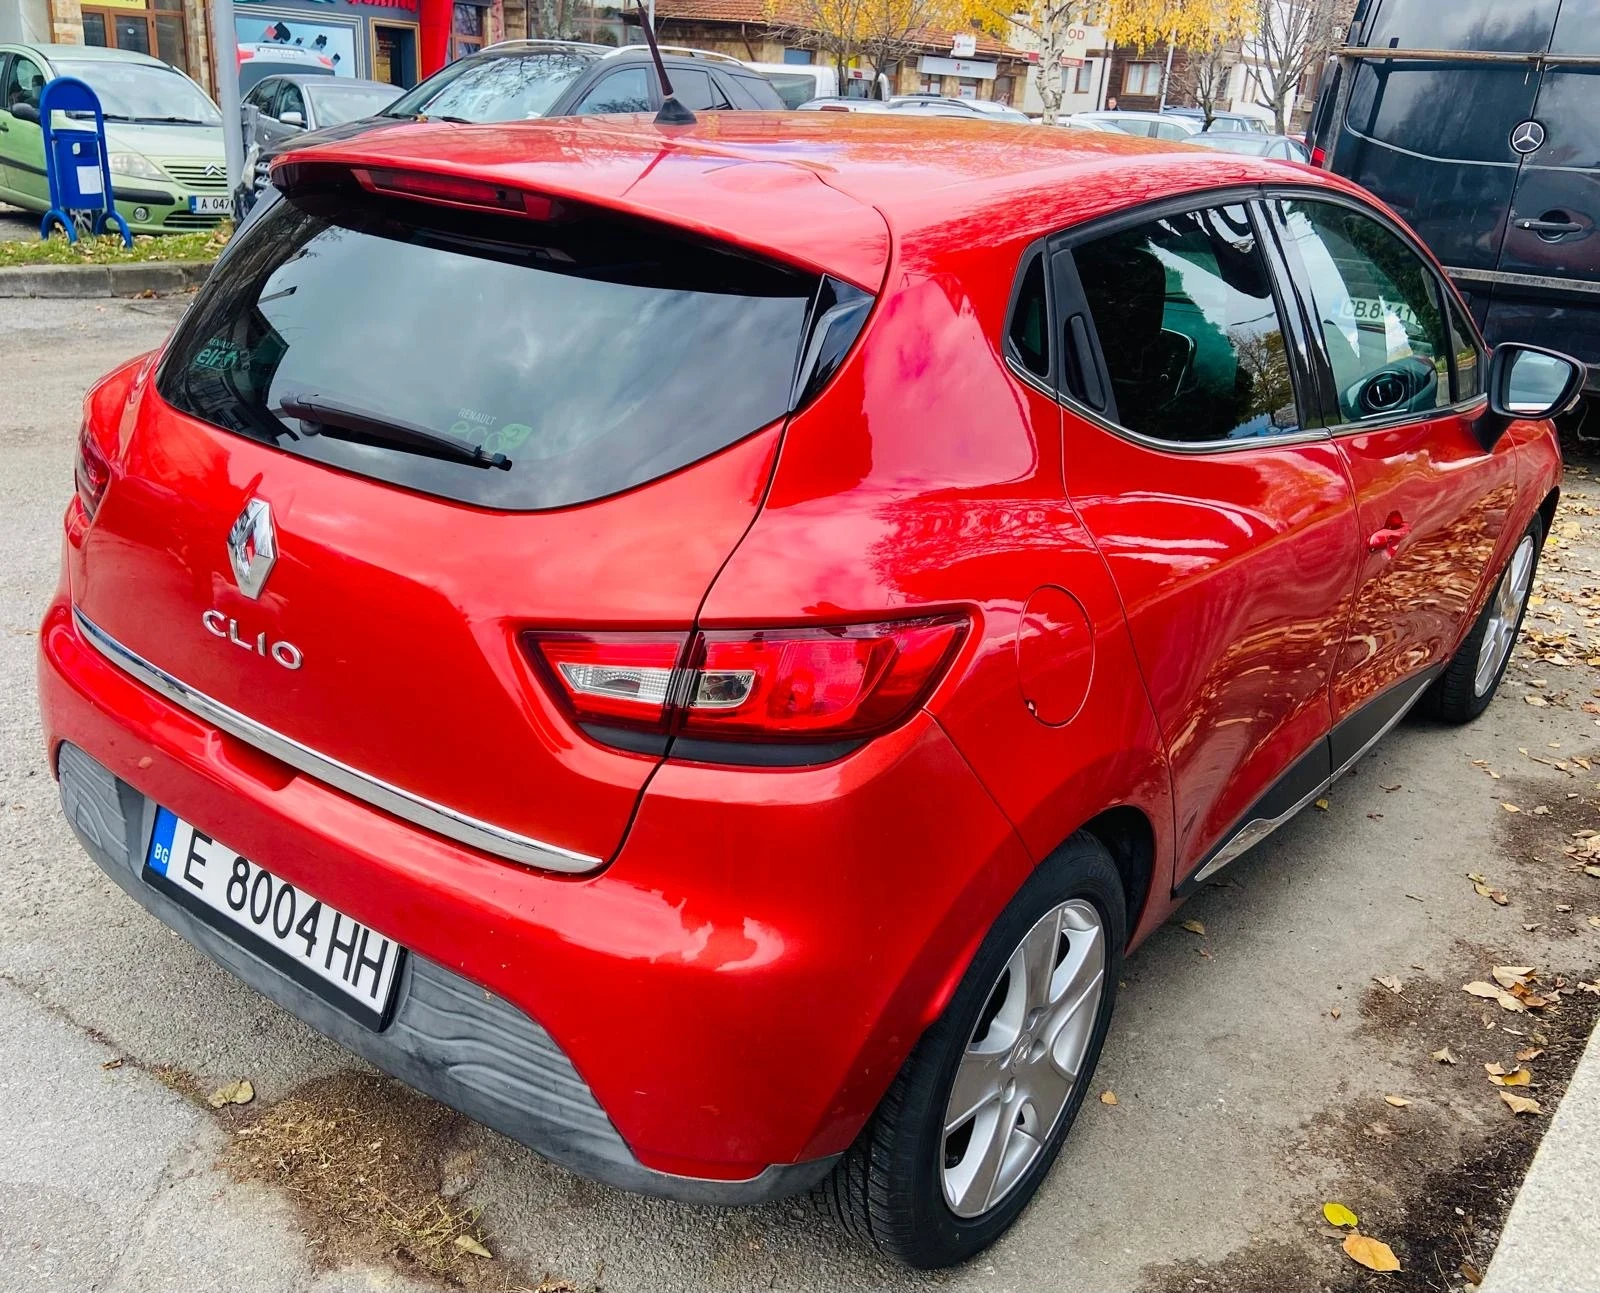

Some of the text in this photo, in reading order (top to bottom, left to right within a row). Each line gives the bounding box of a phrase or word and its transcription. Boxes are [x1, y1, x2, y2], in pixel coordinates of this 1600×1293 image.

[201, 198, 208, 210] A
[457, 407, 497, 425] RENAULT
[201, 608, 303, 671] CLIO
[153, 842, 169, 864] BG
[183, 828, 213, 890] E
